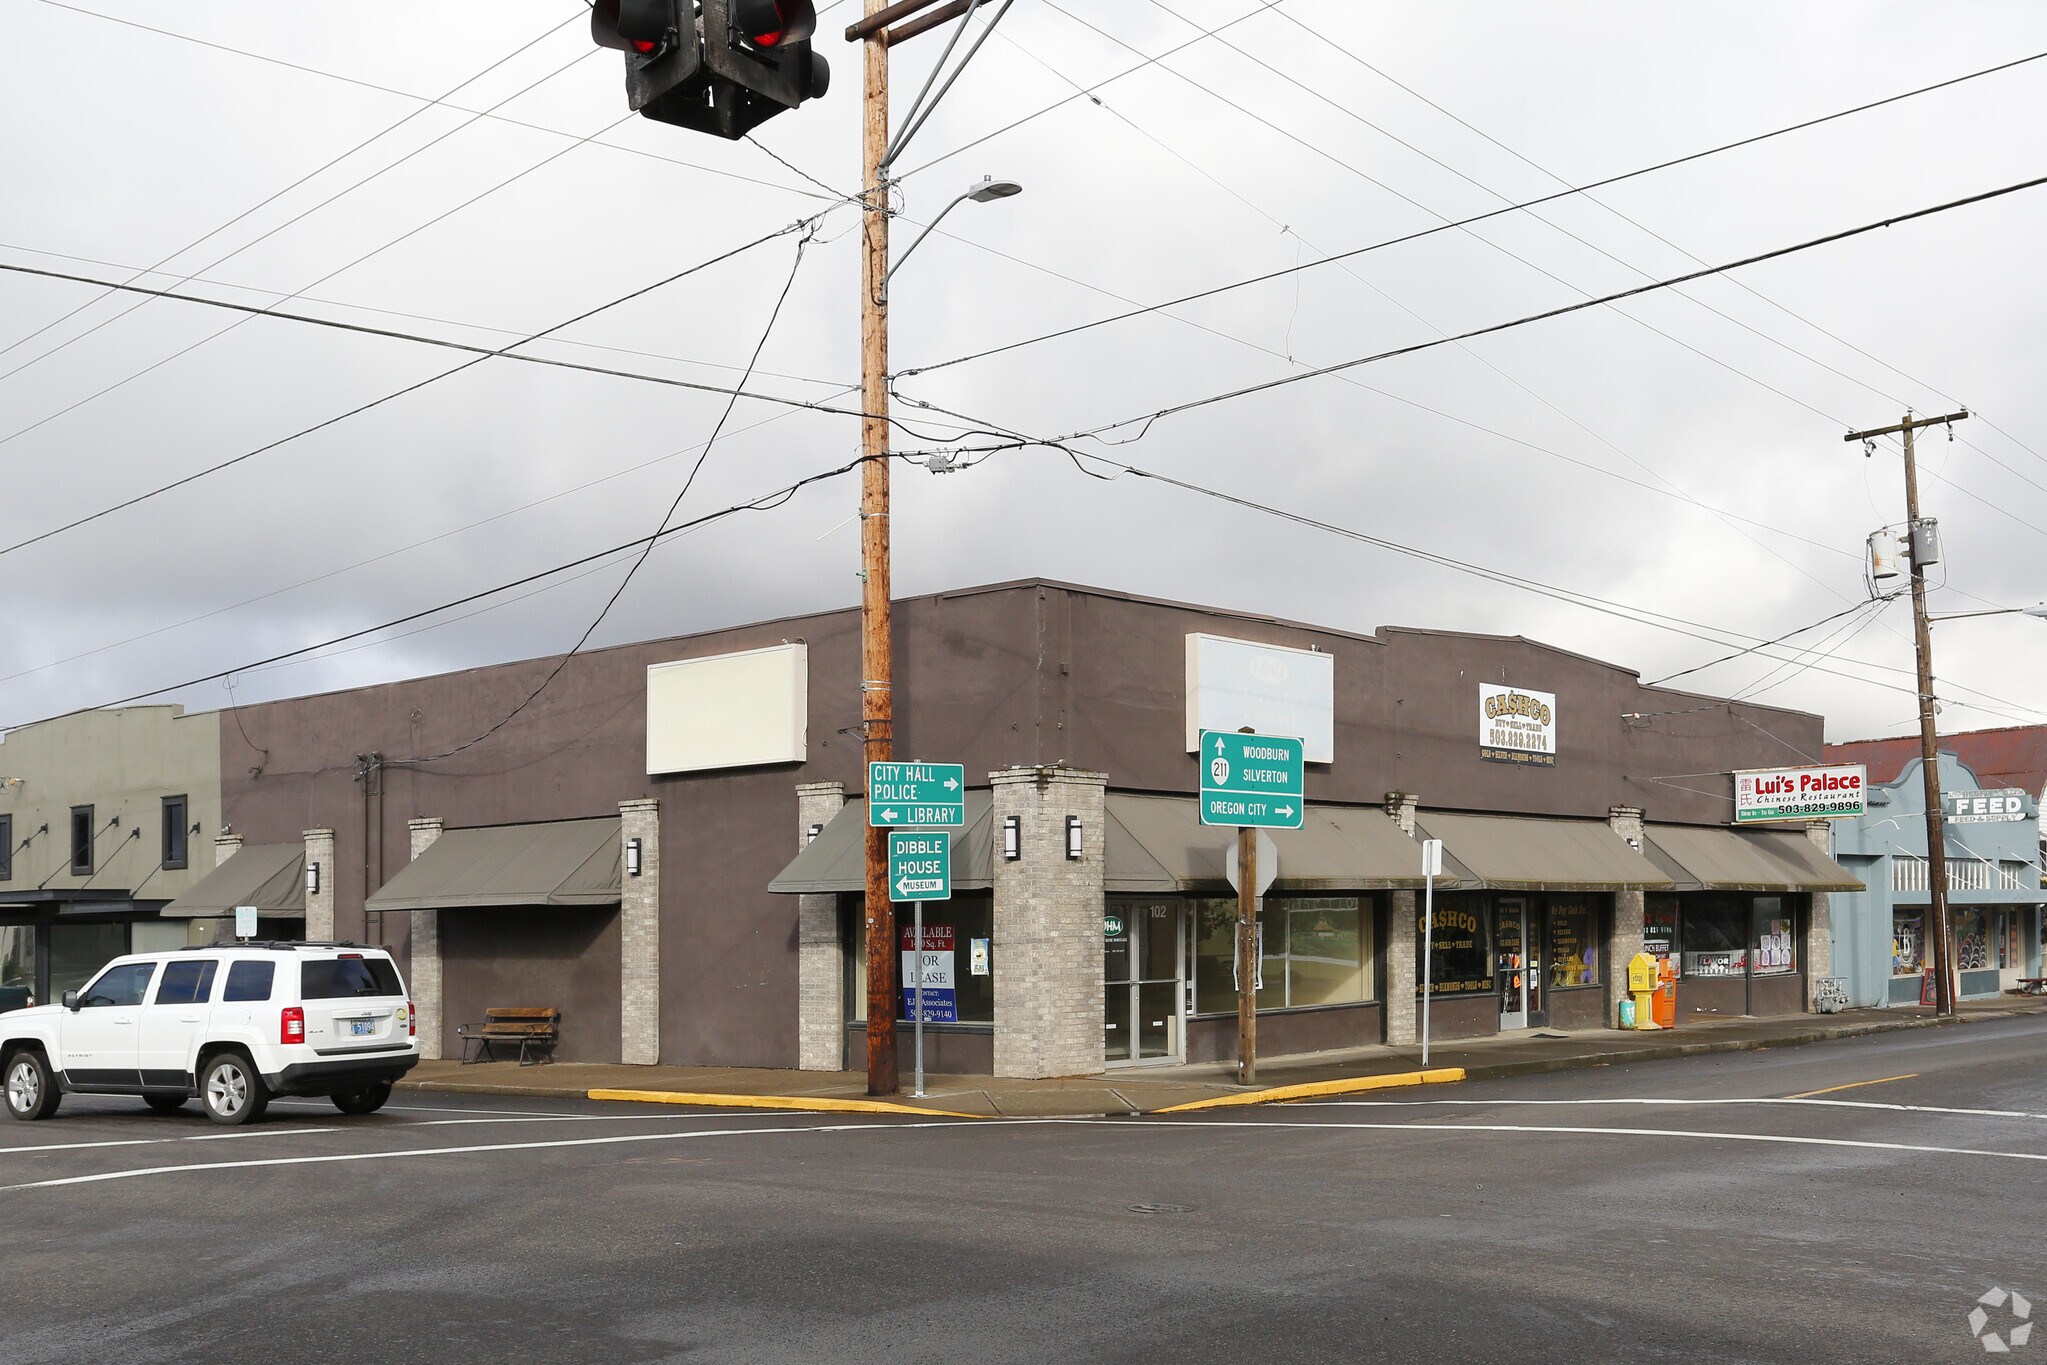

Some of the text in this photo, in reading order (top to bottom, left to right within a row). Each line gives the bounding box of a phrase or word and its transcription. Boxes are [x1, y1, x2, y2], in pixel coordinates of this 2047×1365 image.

[1495, 719, 1542, 732] BUY SELL TRADE
[1243, 746, 1290, 761] WOODBURN
[875, 766, 935, 782] CITY HALL
[1213, 762, 1227, 777] 211
[1243, 769, 1288, 784] SILVERTON
[1755, 773, 1860, 795] Lui's Palace
[875, 784, 918, 800] POLICE
[1756, 791, 1860, 804] Chinese Restaurant
[1210, 801, 1267, 816] OREGON CITY
[1778, 801, 1860, 815] 503-829-9896
[1956, 797, 2022, 815] FEED
[907, 807, 955, 823] LIBRARY
[896, 840, 942, 854] DIBBLE
[898, 860, 941, 874] HOUSE
[902, 881, 937, 890] MUSEUM
[1150, 905, 1166, 918] 102
[904, 926, 952, 938] AVLABLE
[1439, 941, 1452, 950] SELL
[1455, 940, 1473, 949] TRADE
[921, 955, 939, 966] OR
[910, 1009, 952, 1018] 50-829-9140
